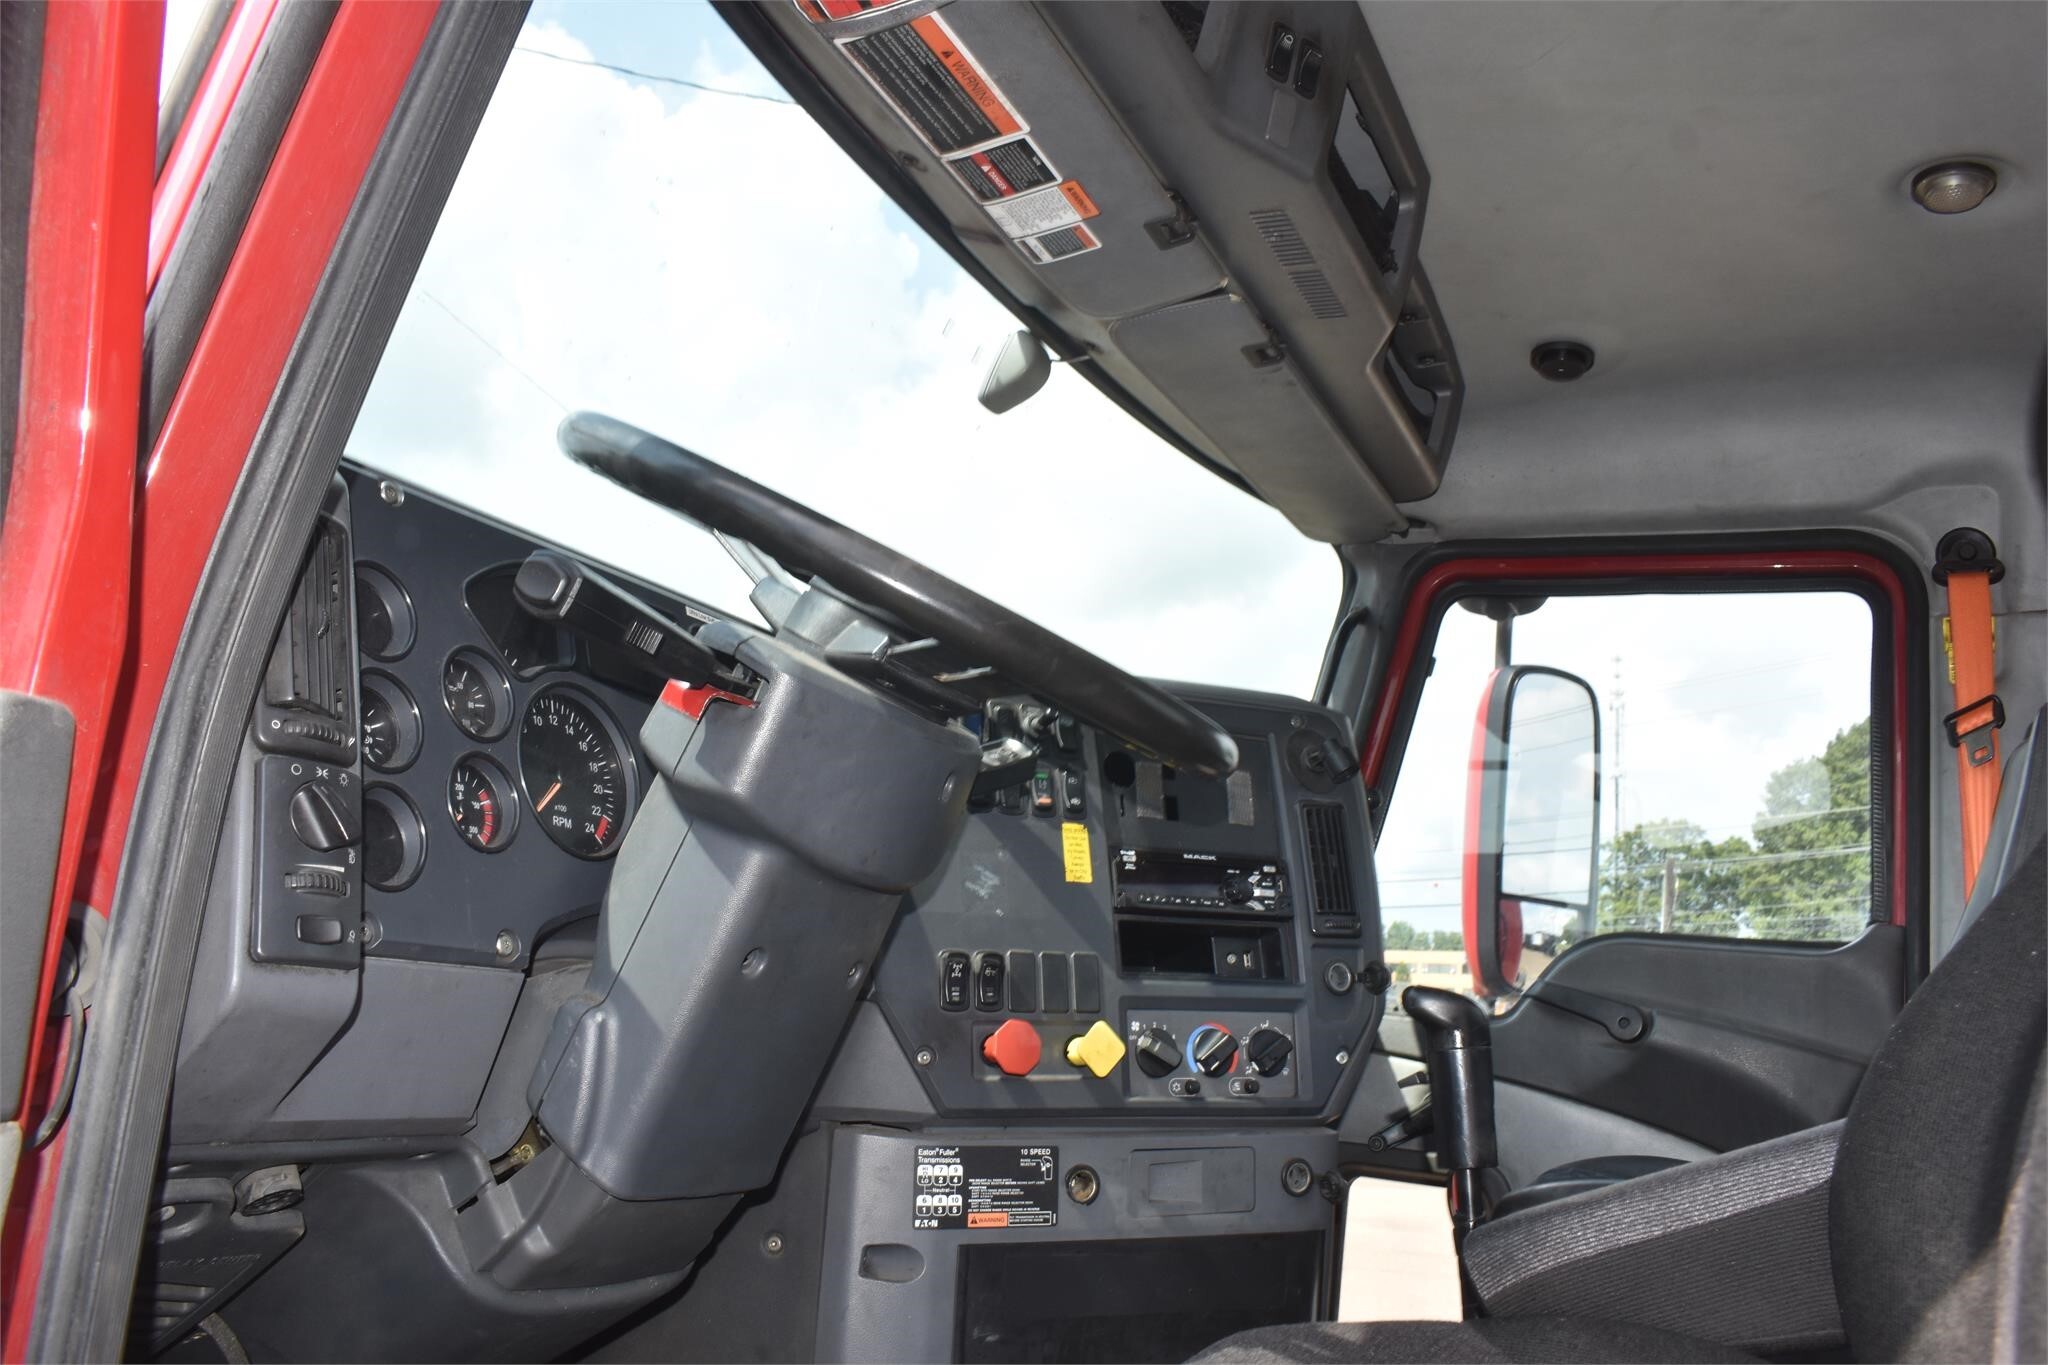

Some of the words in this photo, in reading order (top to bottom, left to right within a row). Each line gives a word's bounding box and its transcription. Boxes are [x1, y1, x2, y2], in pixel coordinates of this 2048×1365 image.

[952, 59, 996, 107] WARNING
[987, 170, 1007, 191] DANGER
[533, 715, 543, 727] 10
[548, 715, 559, 726] 12
[564, 725, 575, 736] 14
[578, 740, 588, 752] 16
[589, 761, 599, 773] 18
[593, 784, 603, 795] 20
[591, 805, 601, 817] 22
[552, 815, 572, 830] RPM
[585, 822, 595, 834] 24
[1183, 853, 1217, 861] MACK
[1020, 1148, 1029, 1156] 10
[1029, 1148, 1051, 1156] SPEED
[918, 1156, 961, 1164] Transmissions
[938, 1166, 944, 1174] 7
[953, 1166, 958, 1174] 9
[938, 1176, 944, 1184] 2
[952, 1176, 958, 1184] 4
[922, 1196, 927, 1204] 6
[938, 1196, 943, 1204] 8
[951, 1196, 959, 1204] 10
[922, 1206, 927, 1214] 1
[937, 1206, 943, 1214] 3
[952, 1206, 958, 1214] 5
